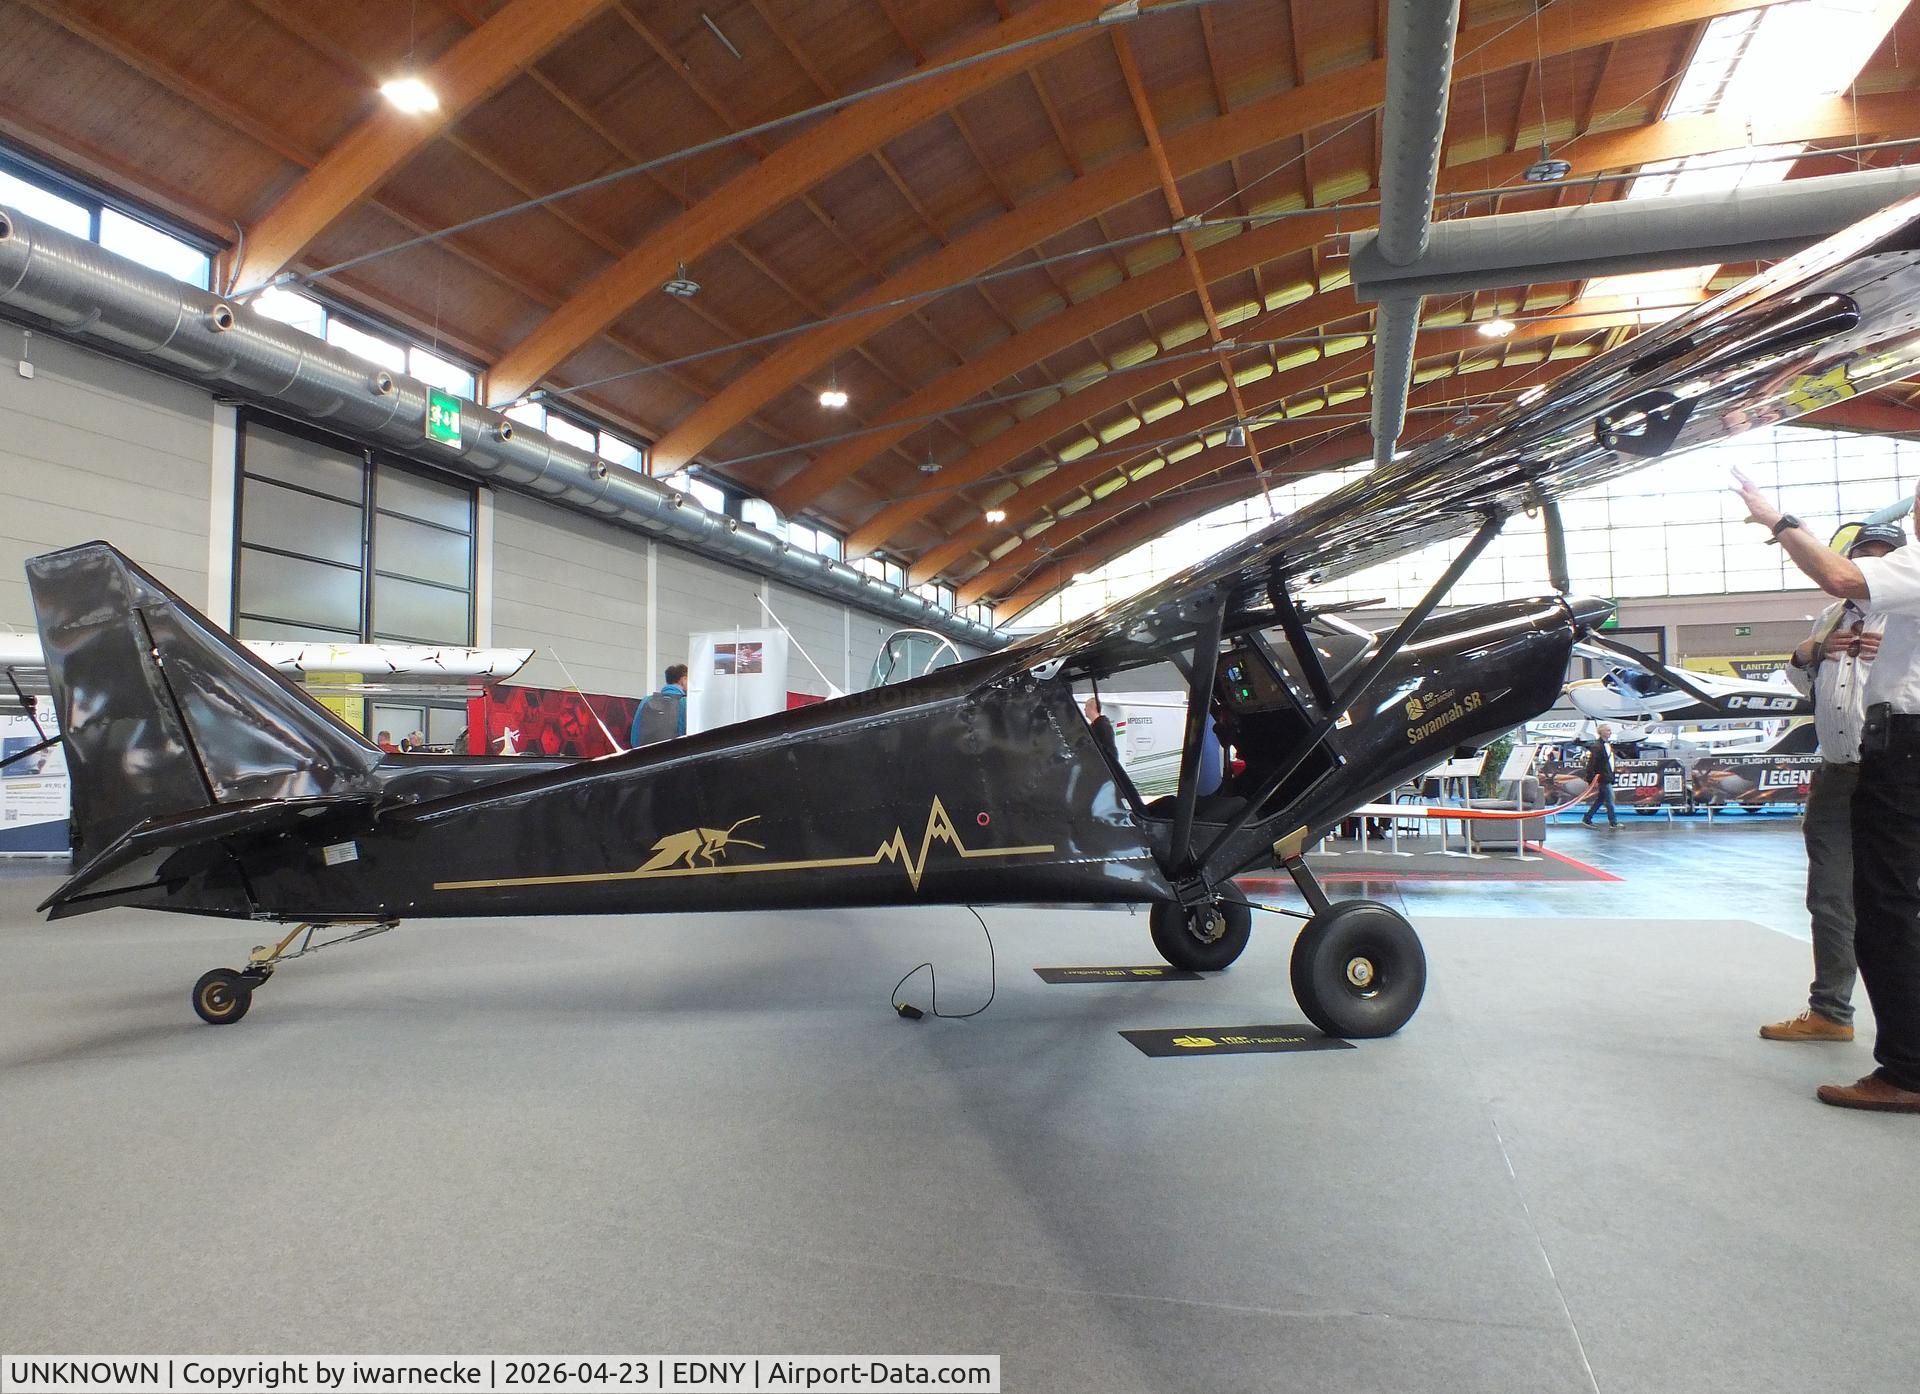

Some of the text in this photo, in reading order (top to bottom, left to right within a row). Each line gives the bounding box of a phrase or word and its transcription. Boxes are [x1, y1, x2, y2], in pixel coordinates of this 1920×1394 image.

[1740, 662, 1771, 671] LANITZ
[1407, 703, 1464, 744] Savannah
[1463, 691, 1483, 713] SR
[1535, 721, 1577, 731] LEGEND
[1775, 757, 1823, 765] SIMULATOR
[1613, 772, 1659, 788] EGEND
[1758, 769, 1815, 791] LEGEN
